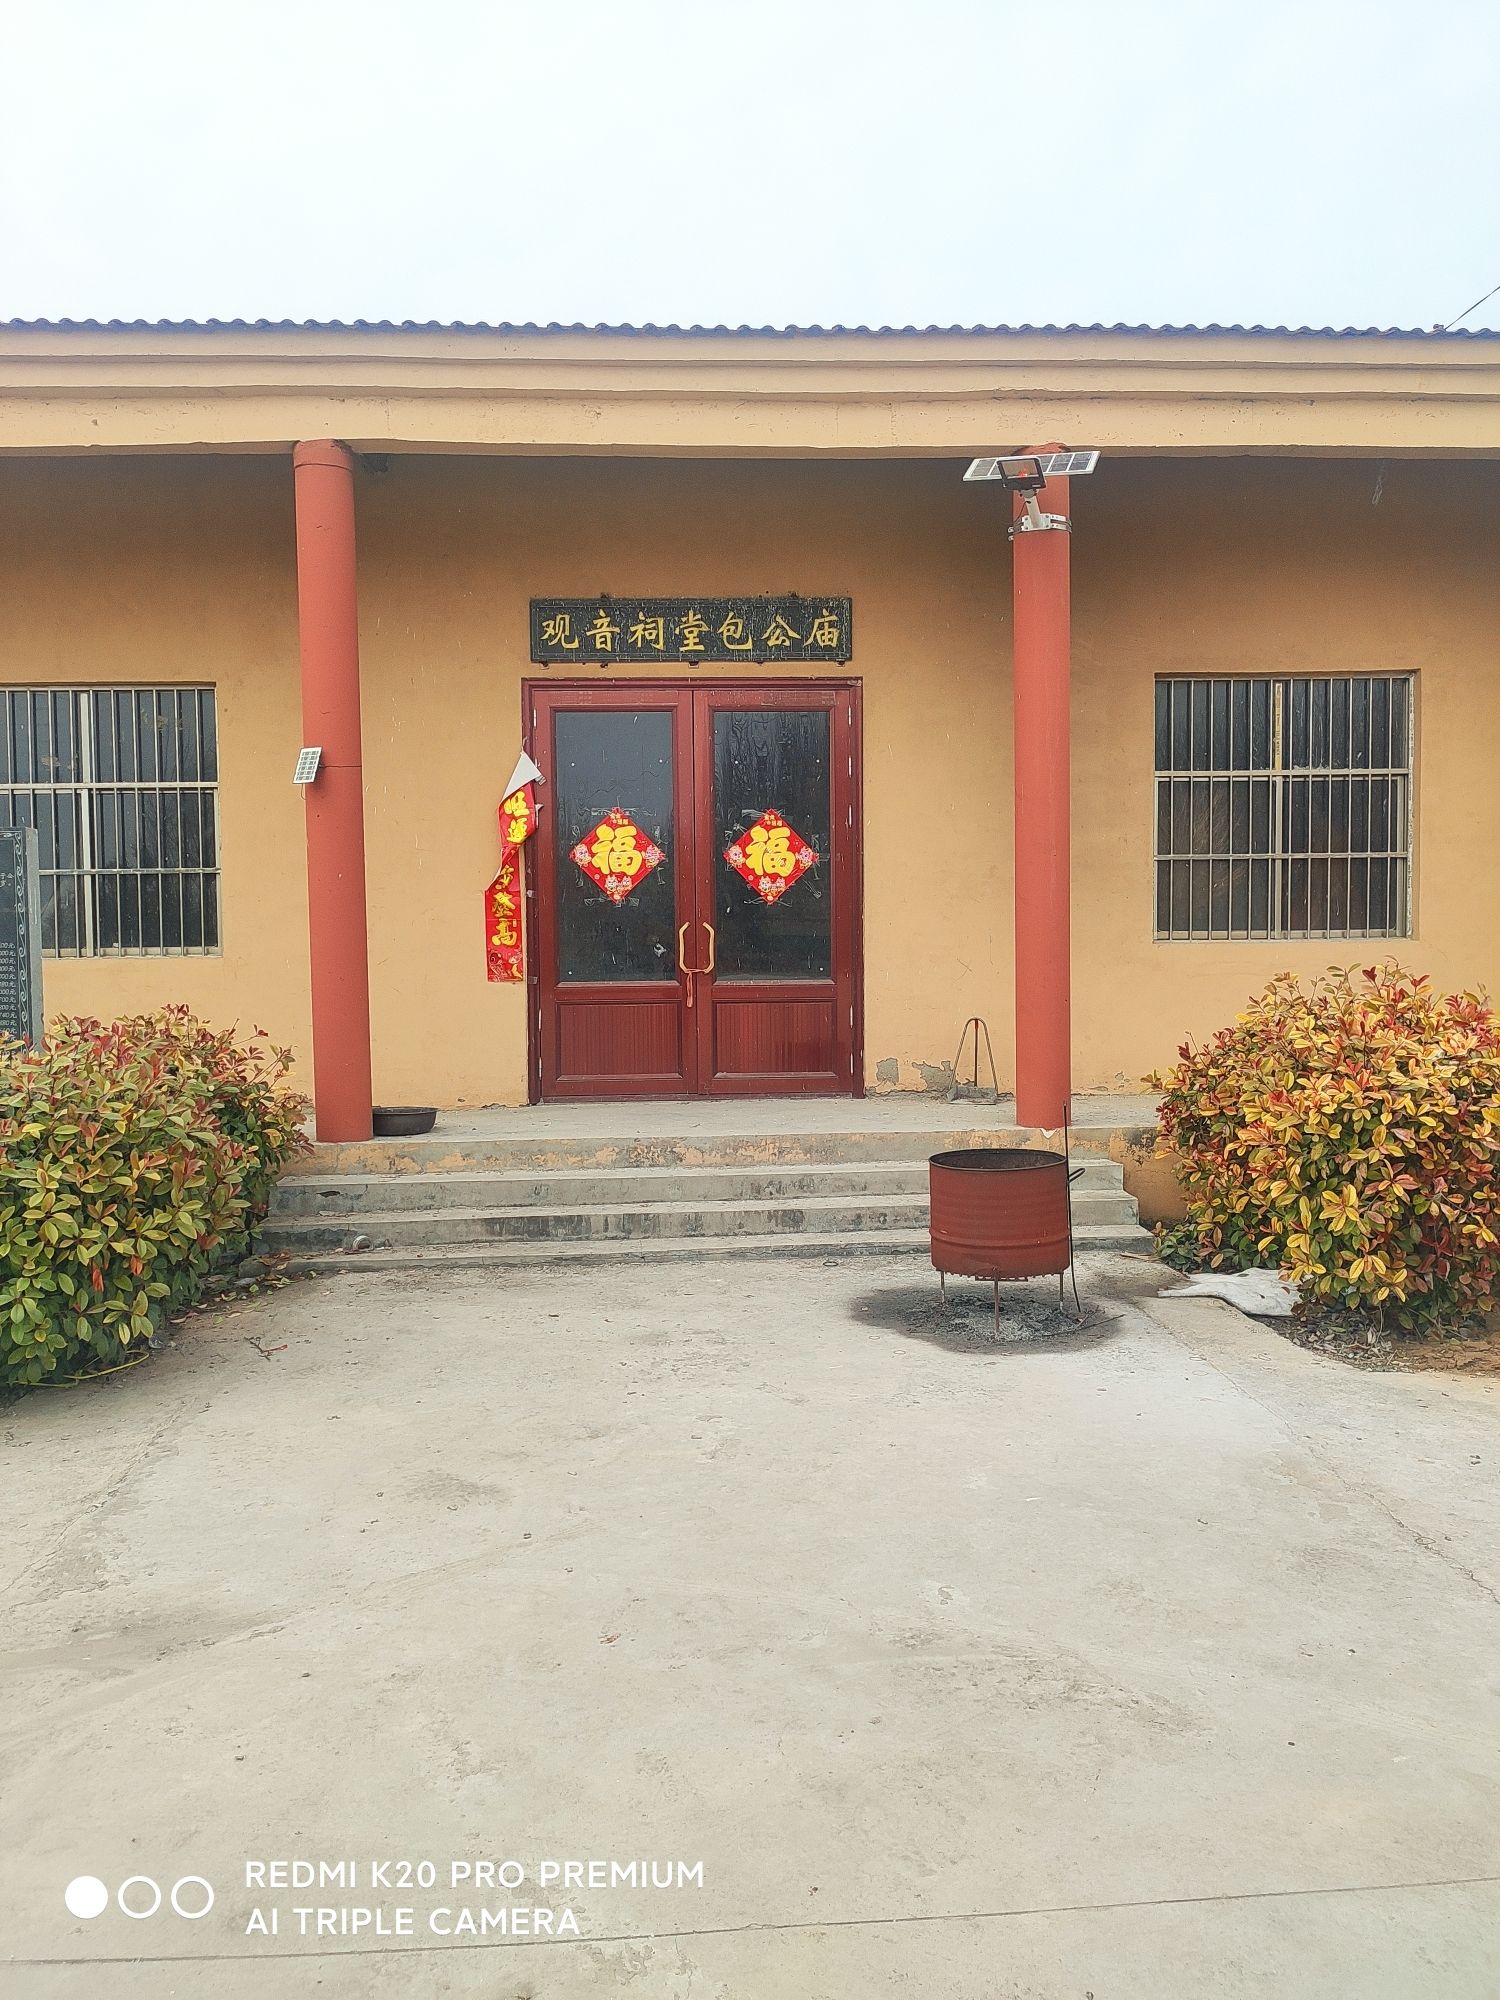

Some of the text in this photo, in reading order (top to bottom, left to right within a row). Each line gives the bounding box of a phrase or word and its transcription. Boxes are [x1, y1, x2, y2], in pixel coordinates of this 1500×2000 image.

[540, 608, 841, 652] 观音祠堂包公庙
[591, 824, 643, 876] 福
[745, 825, 796, 877] 福
